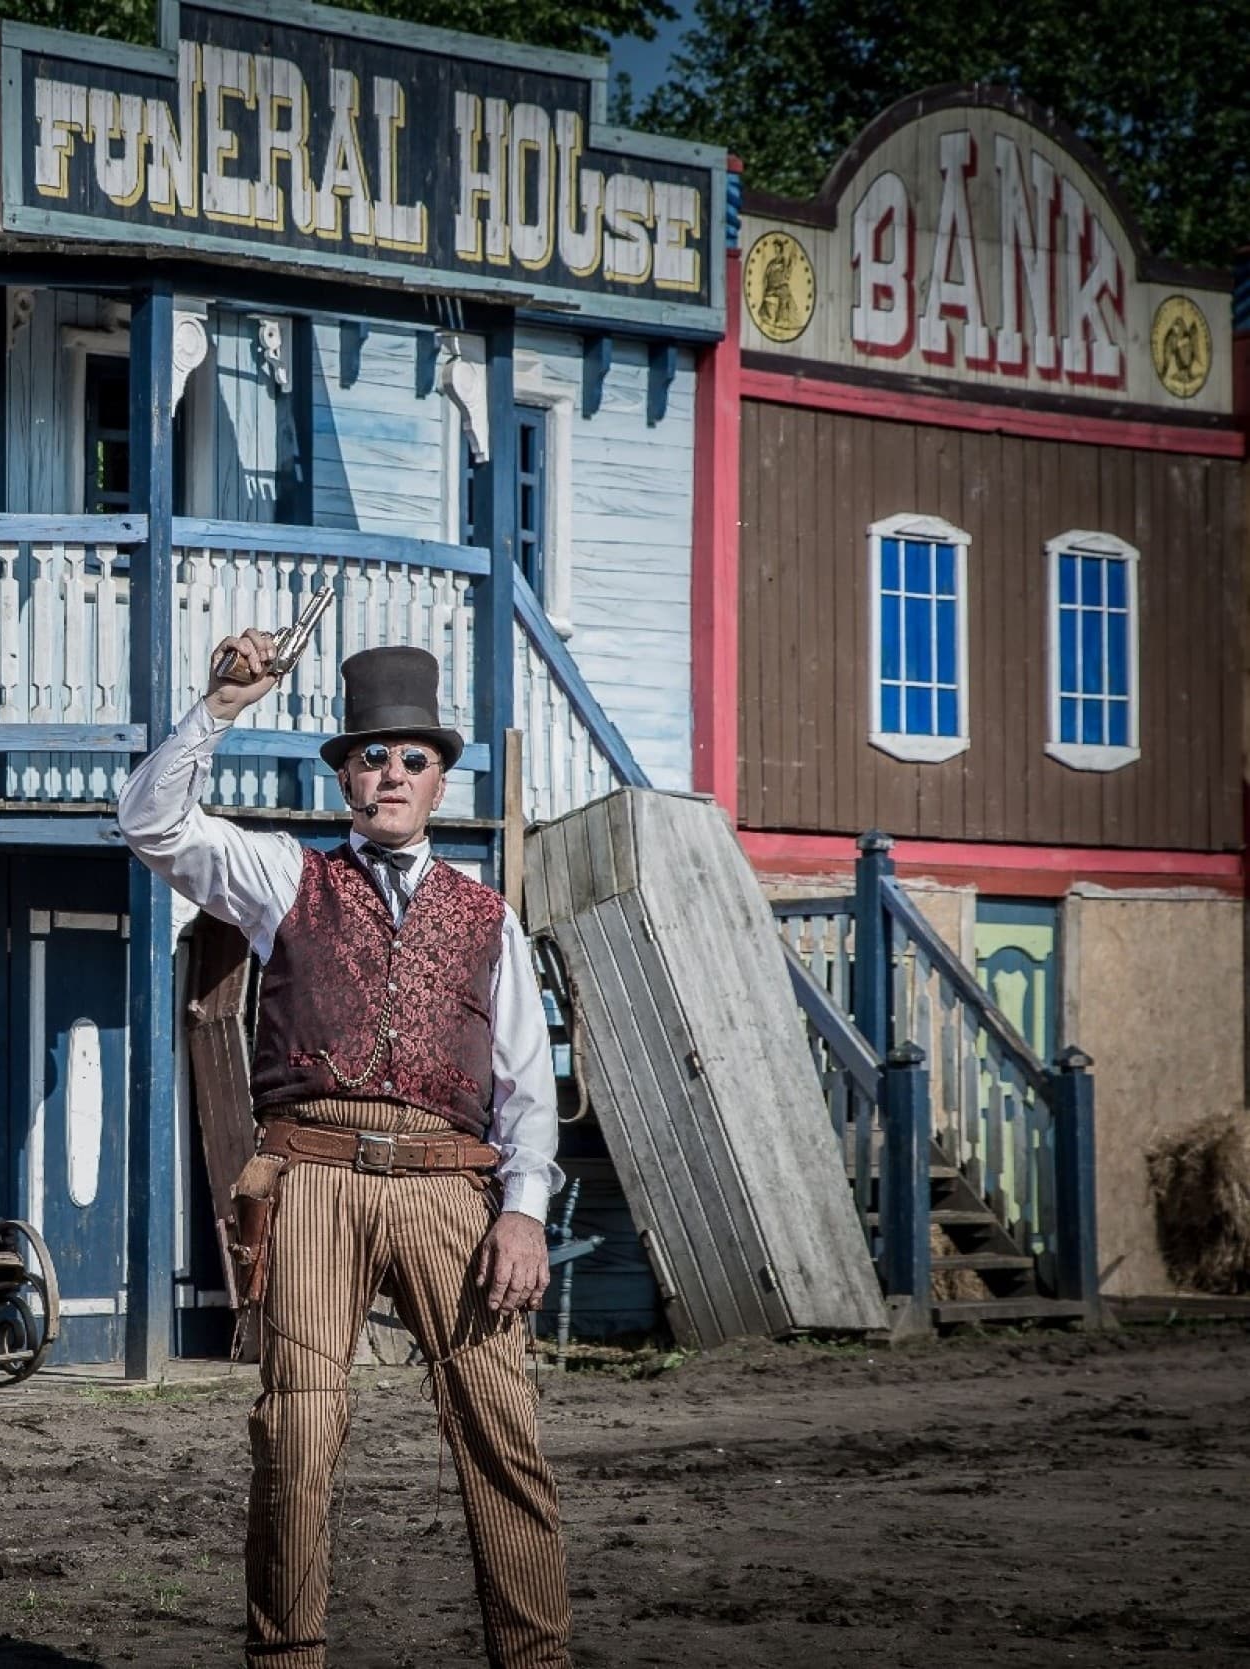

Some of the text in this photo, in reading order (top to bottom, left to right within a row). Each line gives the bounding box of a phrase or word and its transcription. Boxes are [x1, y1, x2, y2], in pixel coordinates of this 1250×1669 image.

[34, 39, 701, 293] FUNERAL HOUSE
[852, 130, 1127, 390] BANK
